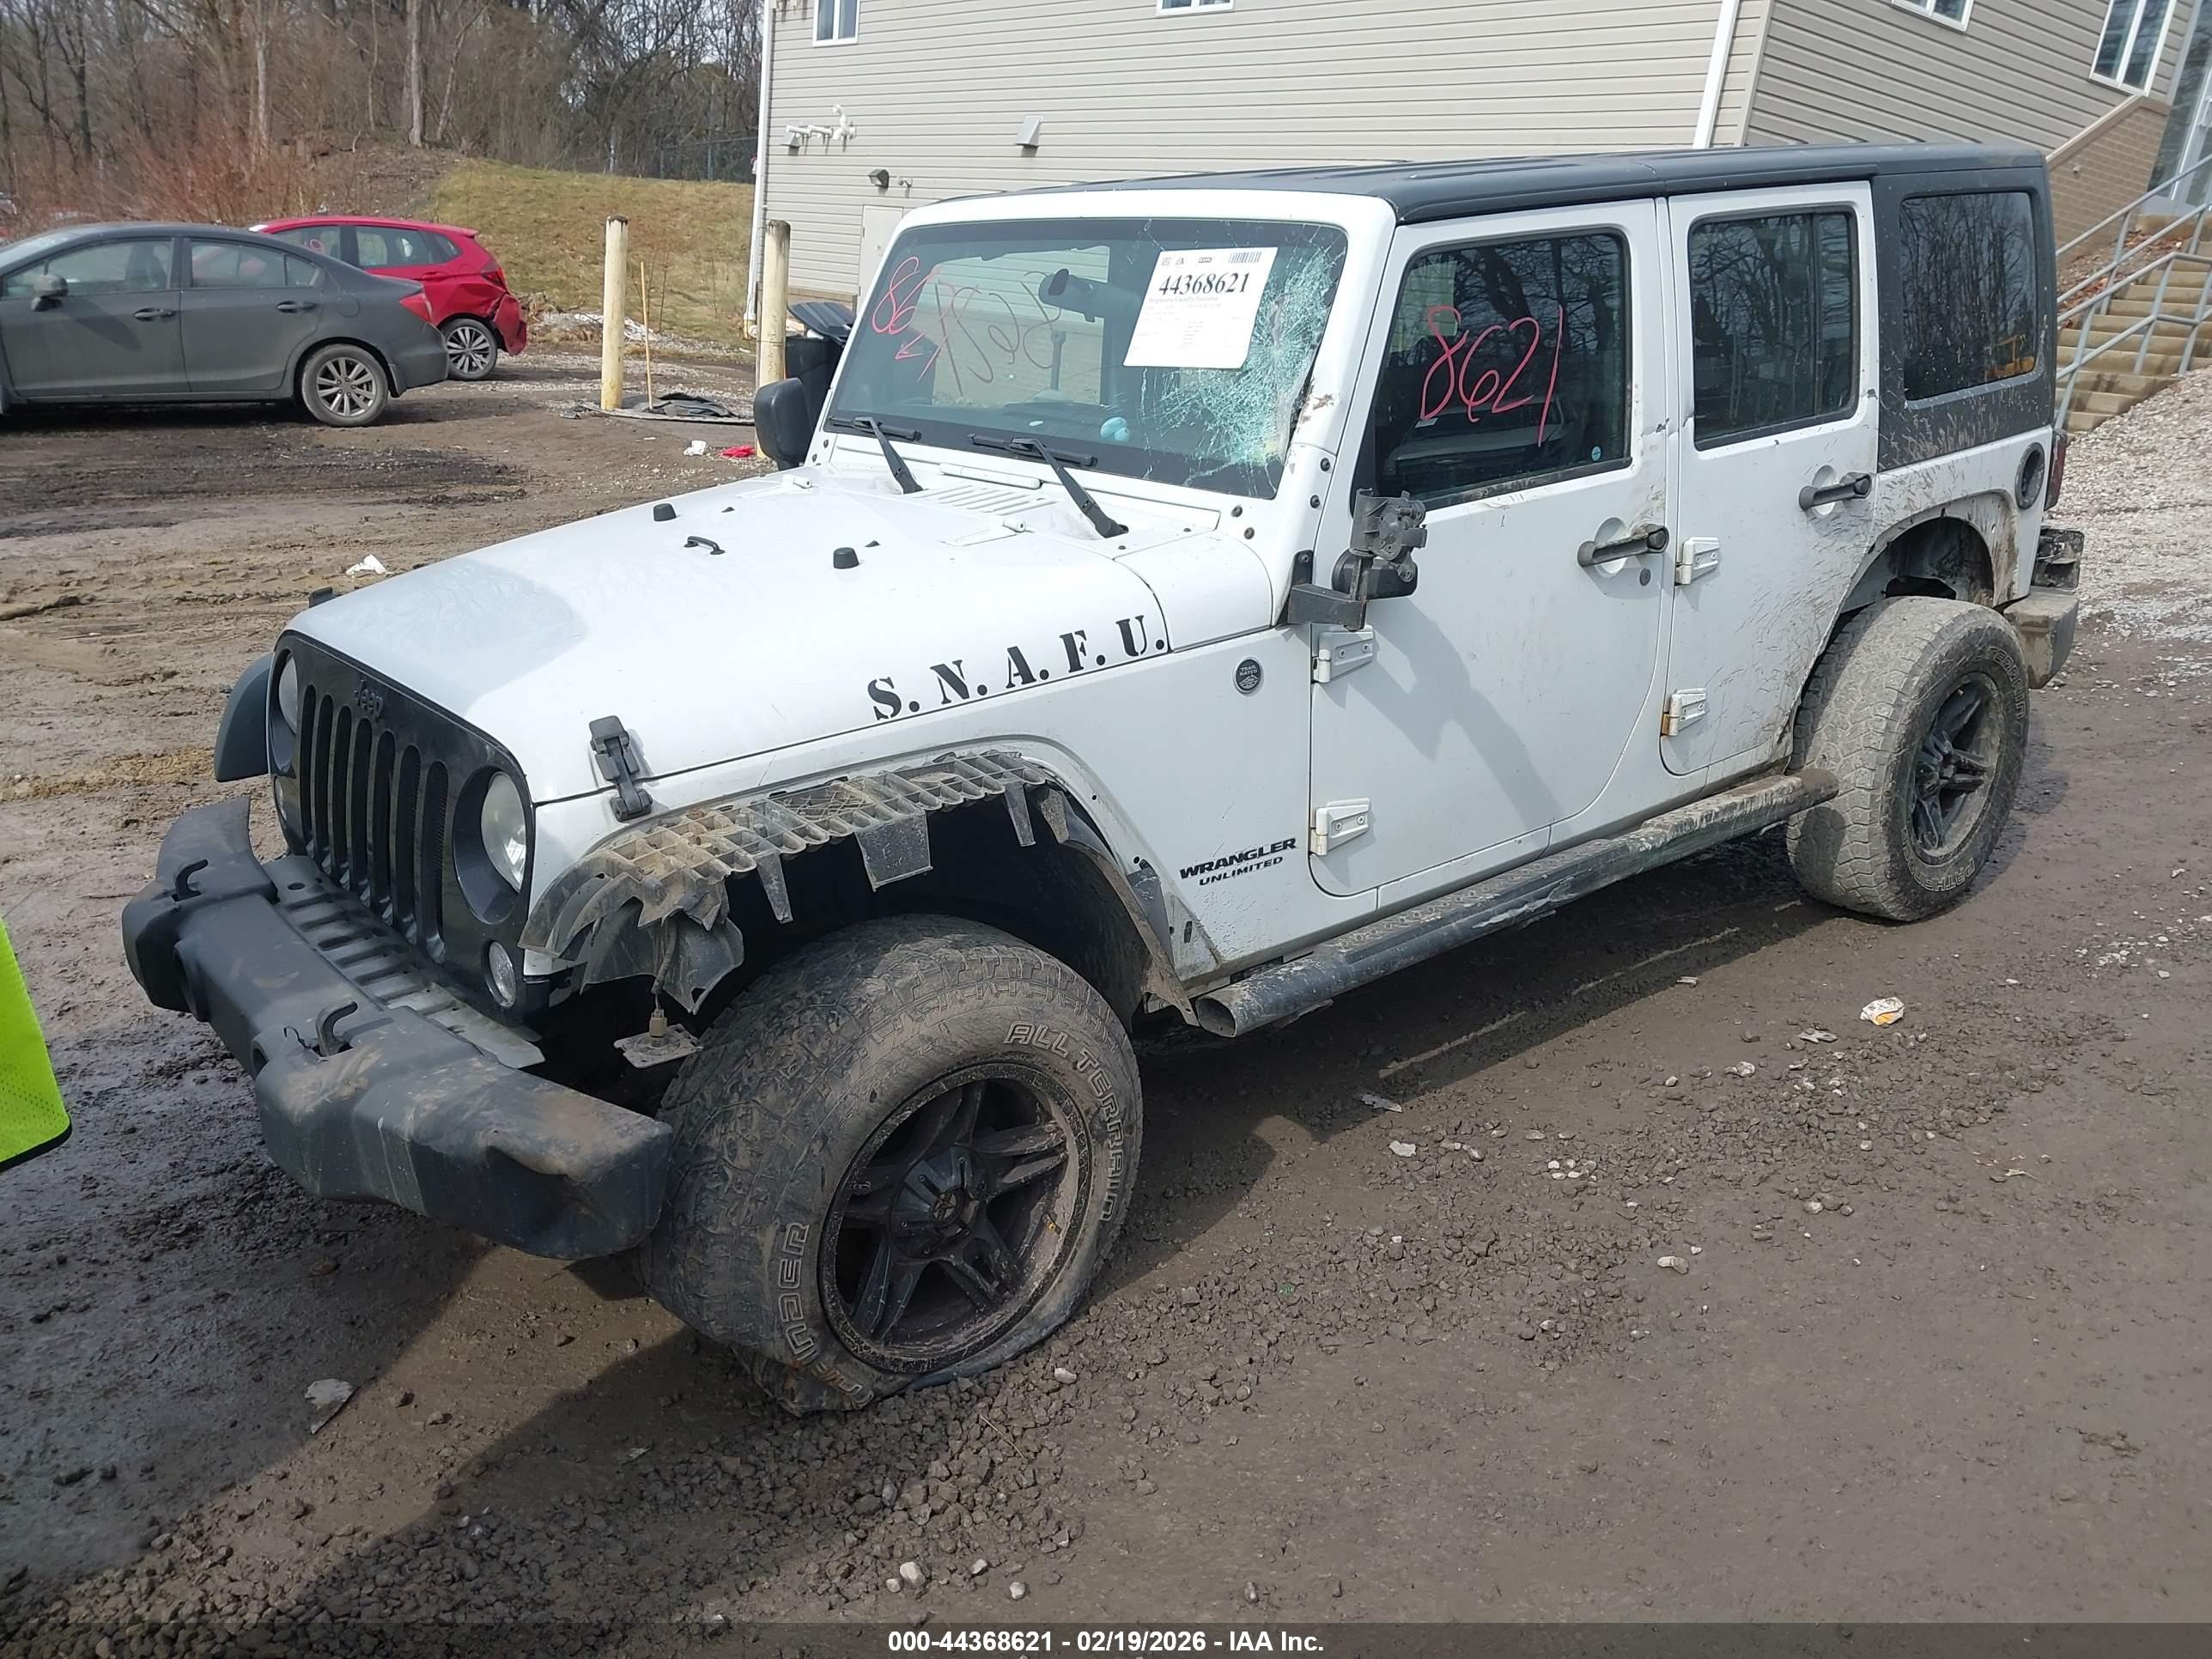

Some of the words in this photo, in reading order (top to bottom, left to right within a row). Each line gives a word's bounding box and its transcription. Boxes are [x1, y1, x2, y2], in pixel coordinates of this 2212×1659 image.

[1158, 271, 1250, 295] 44368621
[1419, 304, 1564, 447] 8621
[1179, 837, 1297, 880] WRANGLER
[1198, 856, 1284, 886] UNLIMITED
[1003, 1023, 1069, 1059] ALL
[1076, 1046, 1124, 1222] TERRAIN
